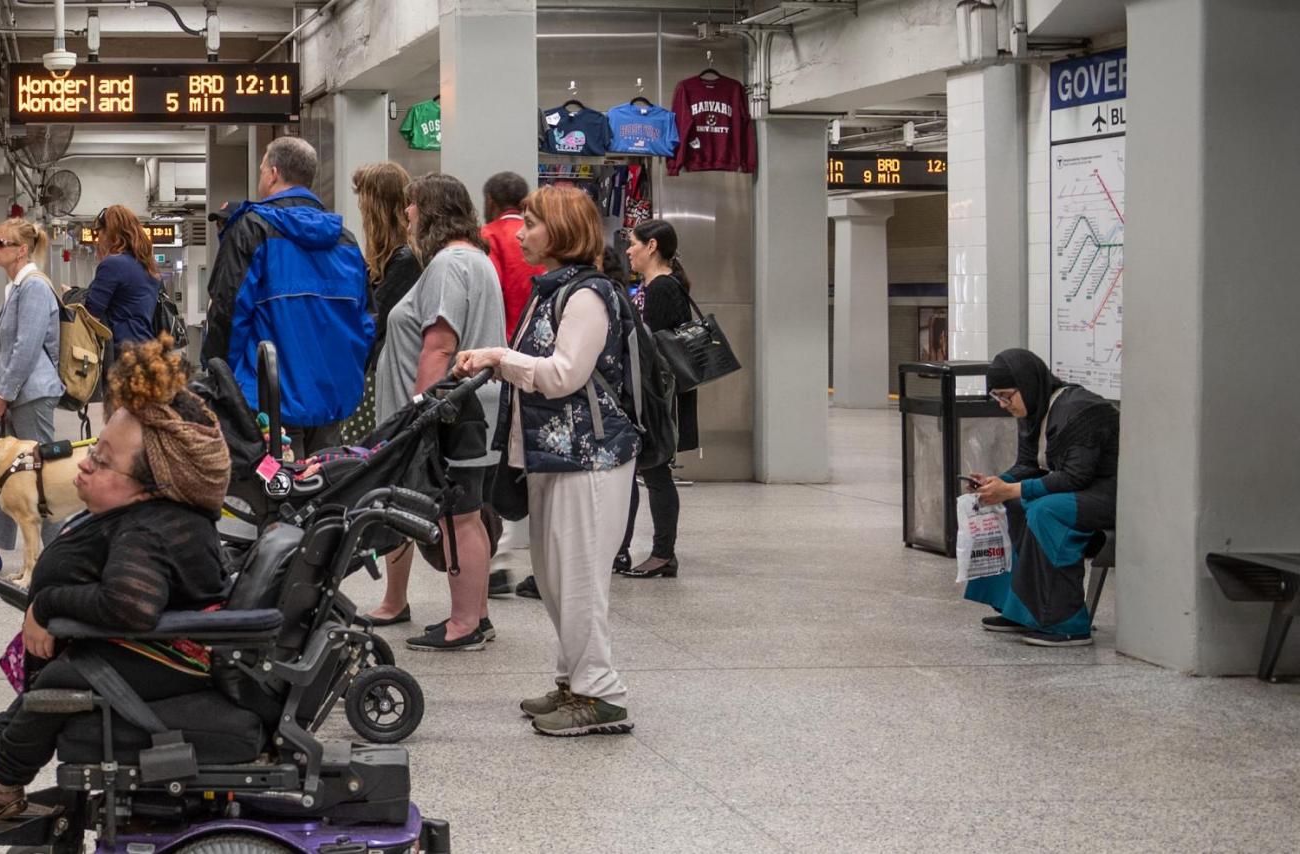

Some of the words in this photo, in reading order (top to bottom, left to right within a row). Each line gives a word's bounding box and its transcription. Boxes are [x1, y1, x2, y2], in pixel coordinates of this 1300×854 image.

[18, 75, 133, 95] Wonderland
[189, 75, 224, 94] BRD
[235, 75, 290, 94] 12:11
[18, 93, 133, 112] Wonderland
[166, 93, 179, 112] 5
[189, 95, 224, 112] min
[691, 101, 733, 117] HARVARD
[1111, 107, 1126, 126] BL
[421, 119, 441, 135] BOS
[826, 158, 844, 171] in
[877, 159, 900, 172] BRD
[927, 160, 946, 173] 12:
[826, 171, 844, 183] in
[863, 170, 872, 183] 9
[877, 171, 900, 183] min
